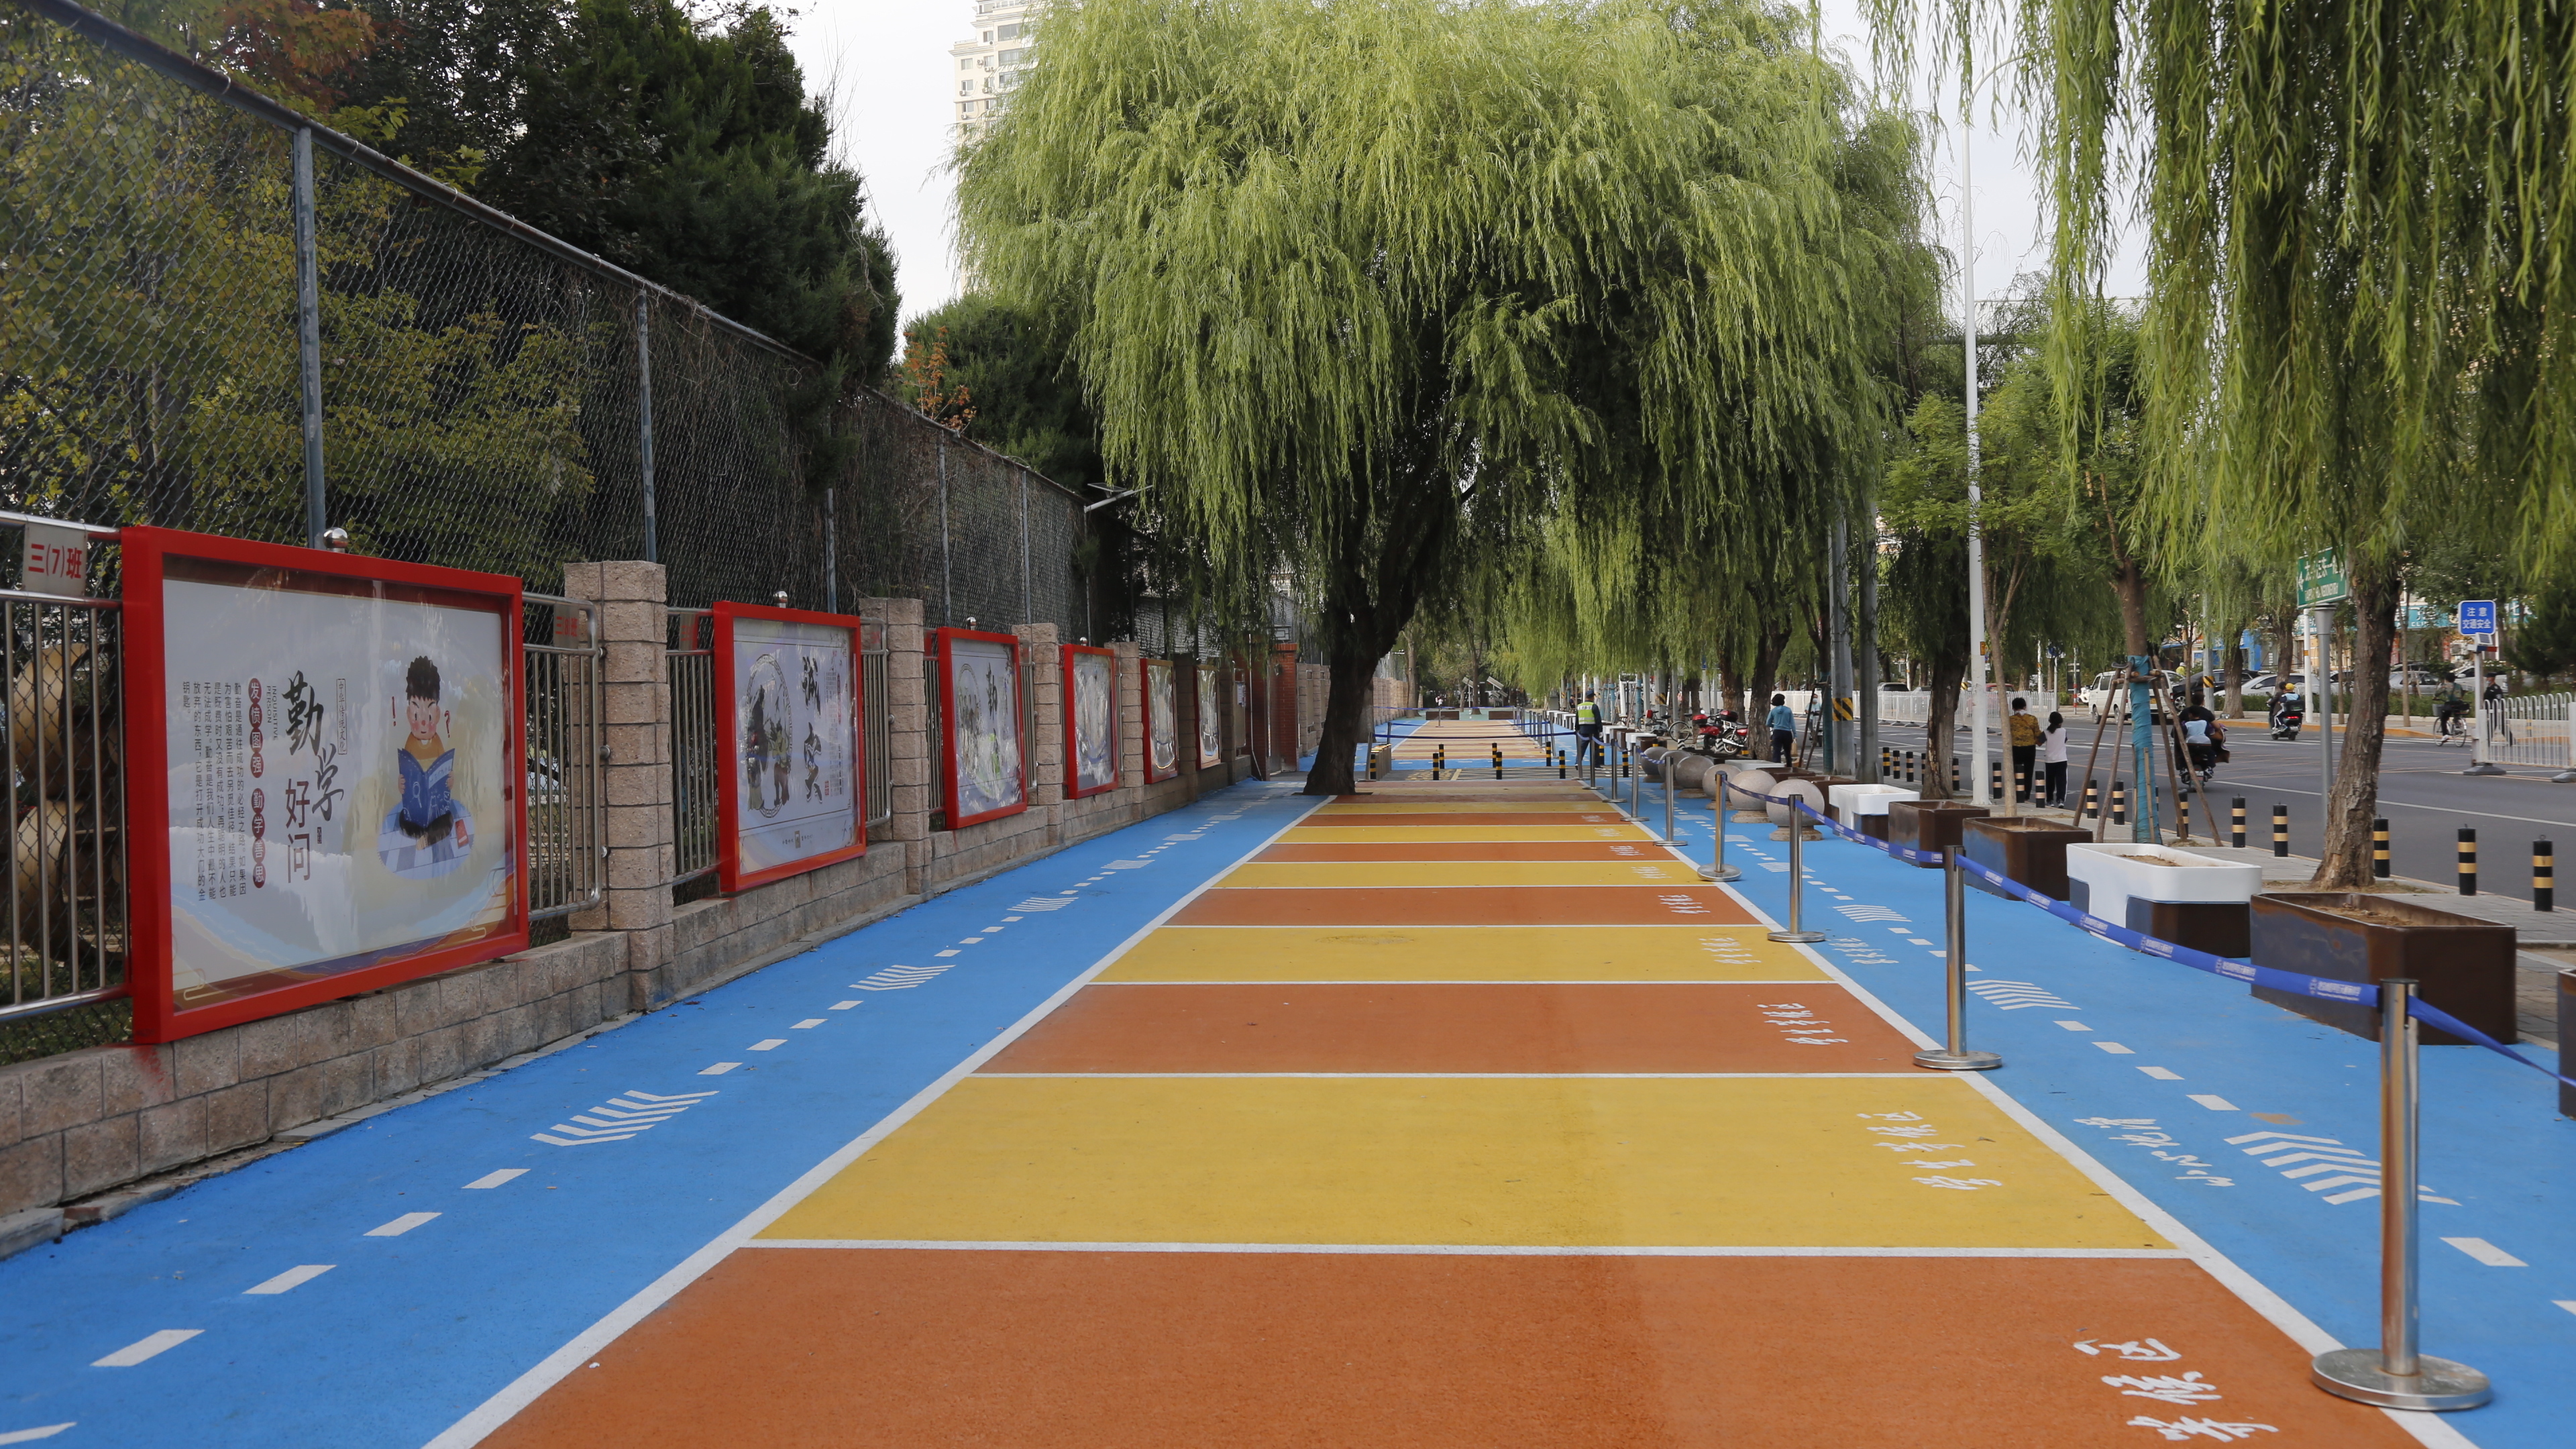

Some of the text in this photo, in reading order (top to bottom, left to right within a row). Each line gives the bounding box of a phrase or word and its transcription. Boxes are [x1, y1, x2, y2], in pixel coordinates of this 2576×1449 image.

[28, 543, 83, 579] 三(7)班
[2463, 619, 2491, 629] 交通安全
[2467, 607, 2487, 616] 注意
[182, 682, 191, 714] 钥匙。
[337, 679, 347, 754] 中华传统文化
[203, 682, 216, 900] 无法成学。勤奋是我们人生中最不能
[234, 682, 247, 895] 勤奋是通往成功的必经之路。如果因
[250, 680, 265, 885] 发愤图强 勤学善思
[1856, 1110, 2002, 1191] 学生等候区
[2073, 1116, 2236, 1187] 小心地滑
